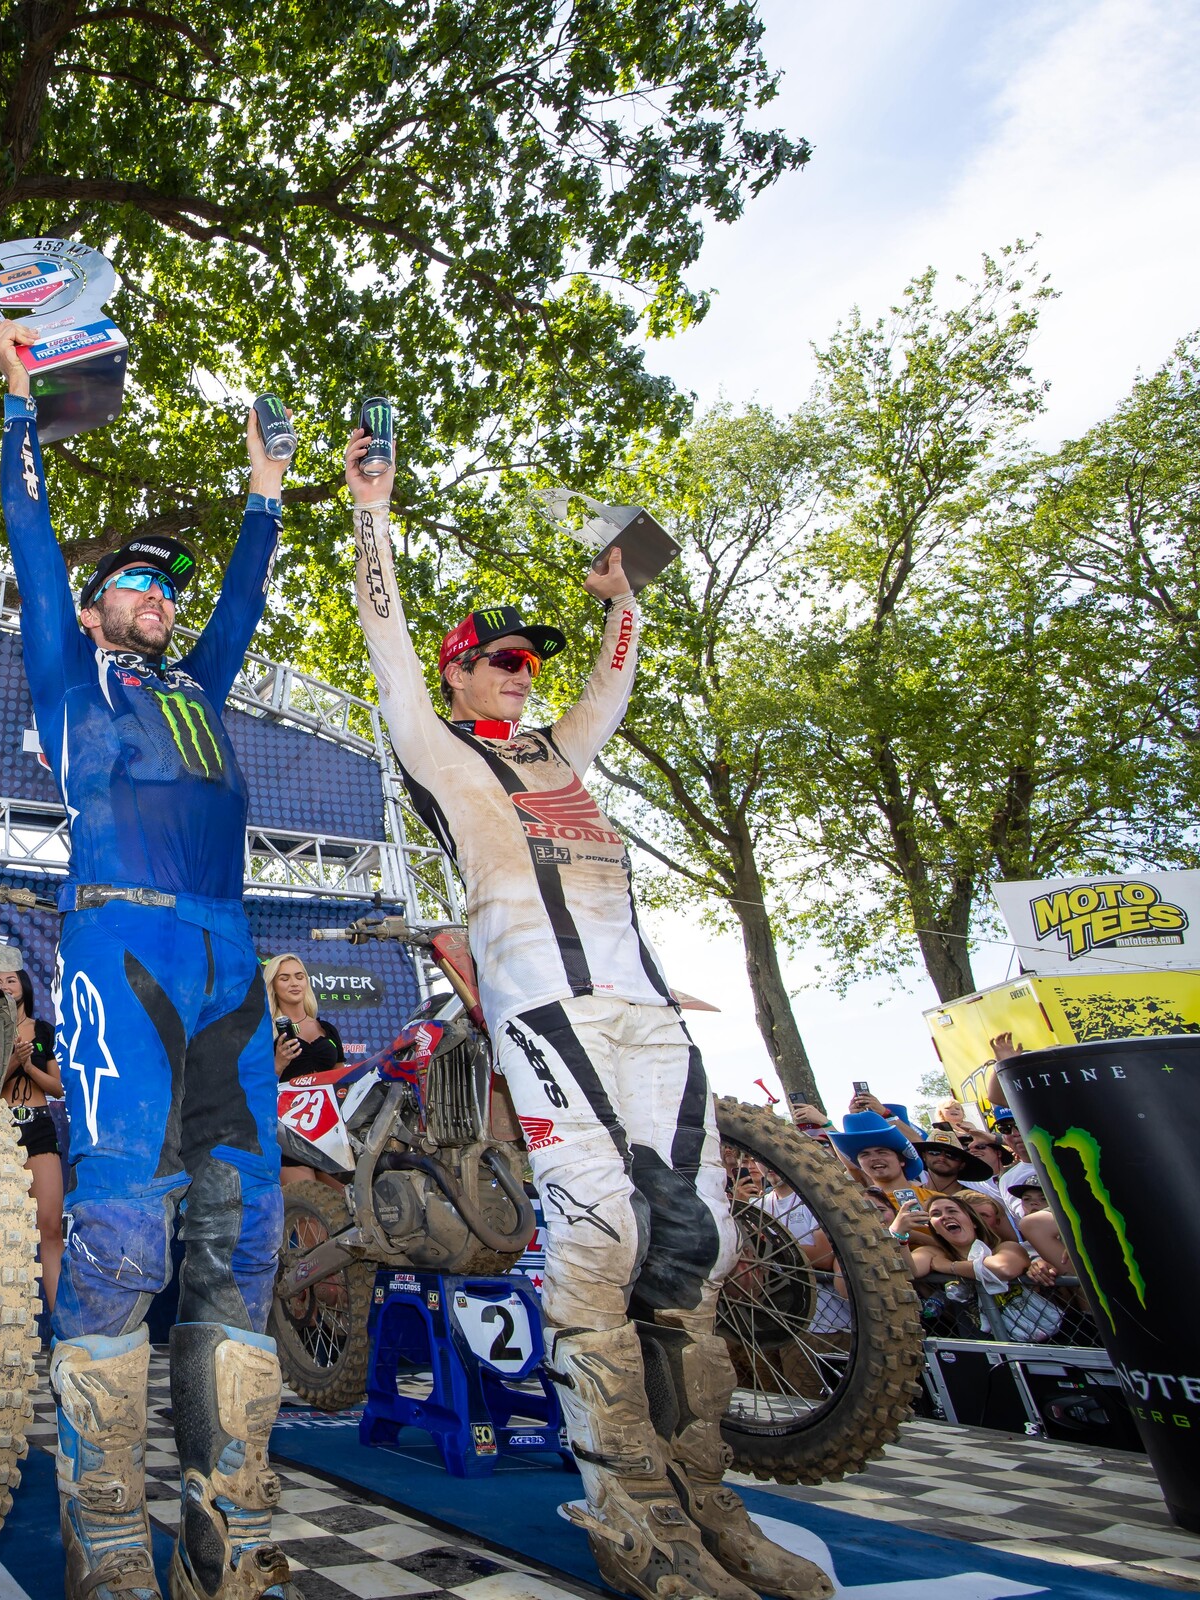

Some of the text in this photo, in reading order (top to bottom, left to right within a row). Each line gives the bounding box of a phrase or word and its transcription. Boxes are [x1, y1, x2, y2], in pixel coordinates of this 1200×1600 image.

[67, 245, 93, 255] MX
[6, 277, 48, 294] REDBUD
[6, 284, 58, 301] NATIONAL
[36, 332, 107, 359] MOTOCROSS
[49, 332, 87, 348] LUCAS OIL
[139, 543, 171, 559] YAMAHA
[360, 510, 390, 619] alpinestars
[452, 638, 469, 653] FOX
[610, 609, 634, 672] HONDA
[525, 823, 624, 845] HOND
[585, 855, 620, 864] DUNLOP
[1032, 882, 1158, 936] MOTO
[1061, 905, 1186, 958] TEES
[1114, 935, 1181, 948] mototees.com
[312, 973, 376, 991] NSTER
[320, 993, 362, 1001] ERGY
[1010, 987, 1027, 1000] EVENT
[414, 1050, 432, 1059] ONDA
[295, 1075, 312, 1085] USA
[281, 1091, 325, 1131] 23
[527, 1135, 565, 1153] ONDA
[375, 1288, 383, 1297] 50
[389, 1283, 421, 1291] MOTOCROSS
[429, 1292, 438, 1302] 50
[480, 1305, 523, 1361] 2
[475, 1426, 494, 1444] 50
[509, 1436, 545, 1444] ACERBIS
